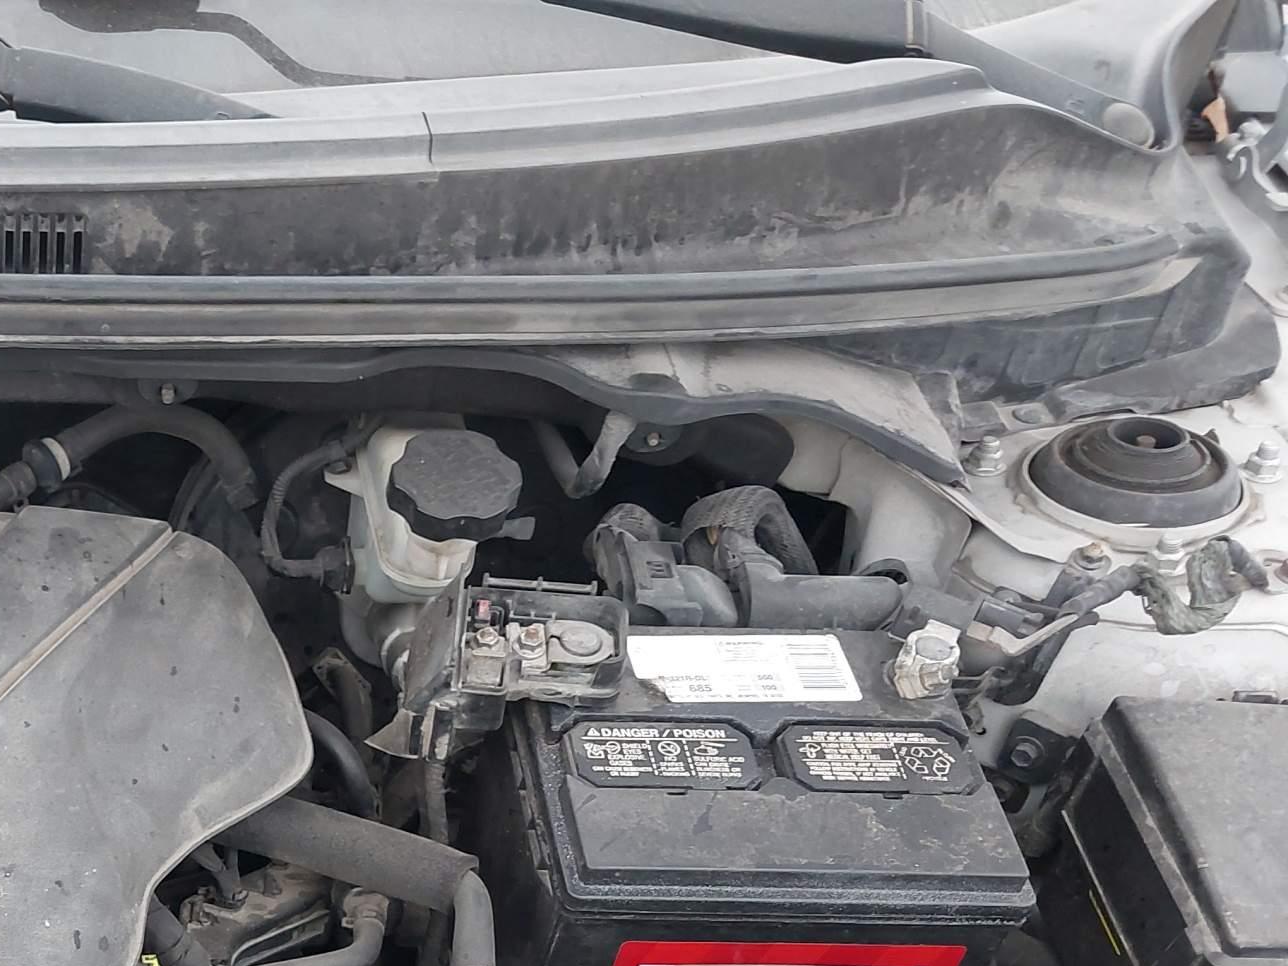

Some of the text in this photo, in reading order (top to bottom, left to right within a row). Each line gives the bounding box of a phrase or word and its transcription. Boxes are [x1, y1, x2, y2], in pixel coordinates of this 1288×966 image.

[689, 684, 712, 692] 685
[600, 728, 660, 738] DANGER
[673, 729, 726, 738] POISON
